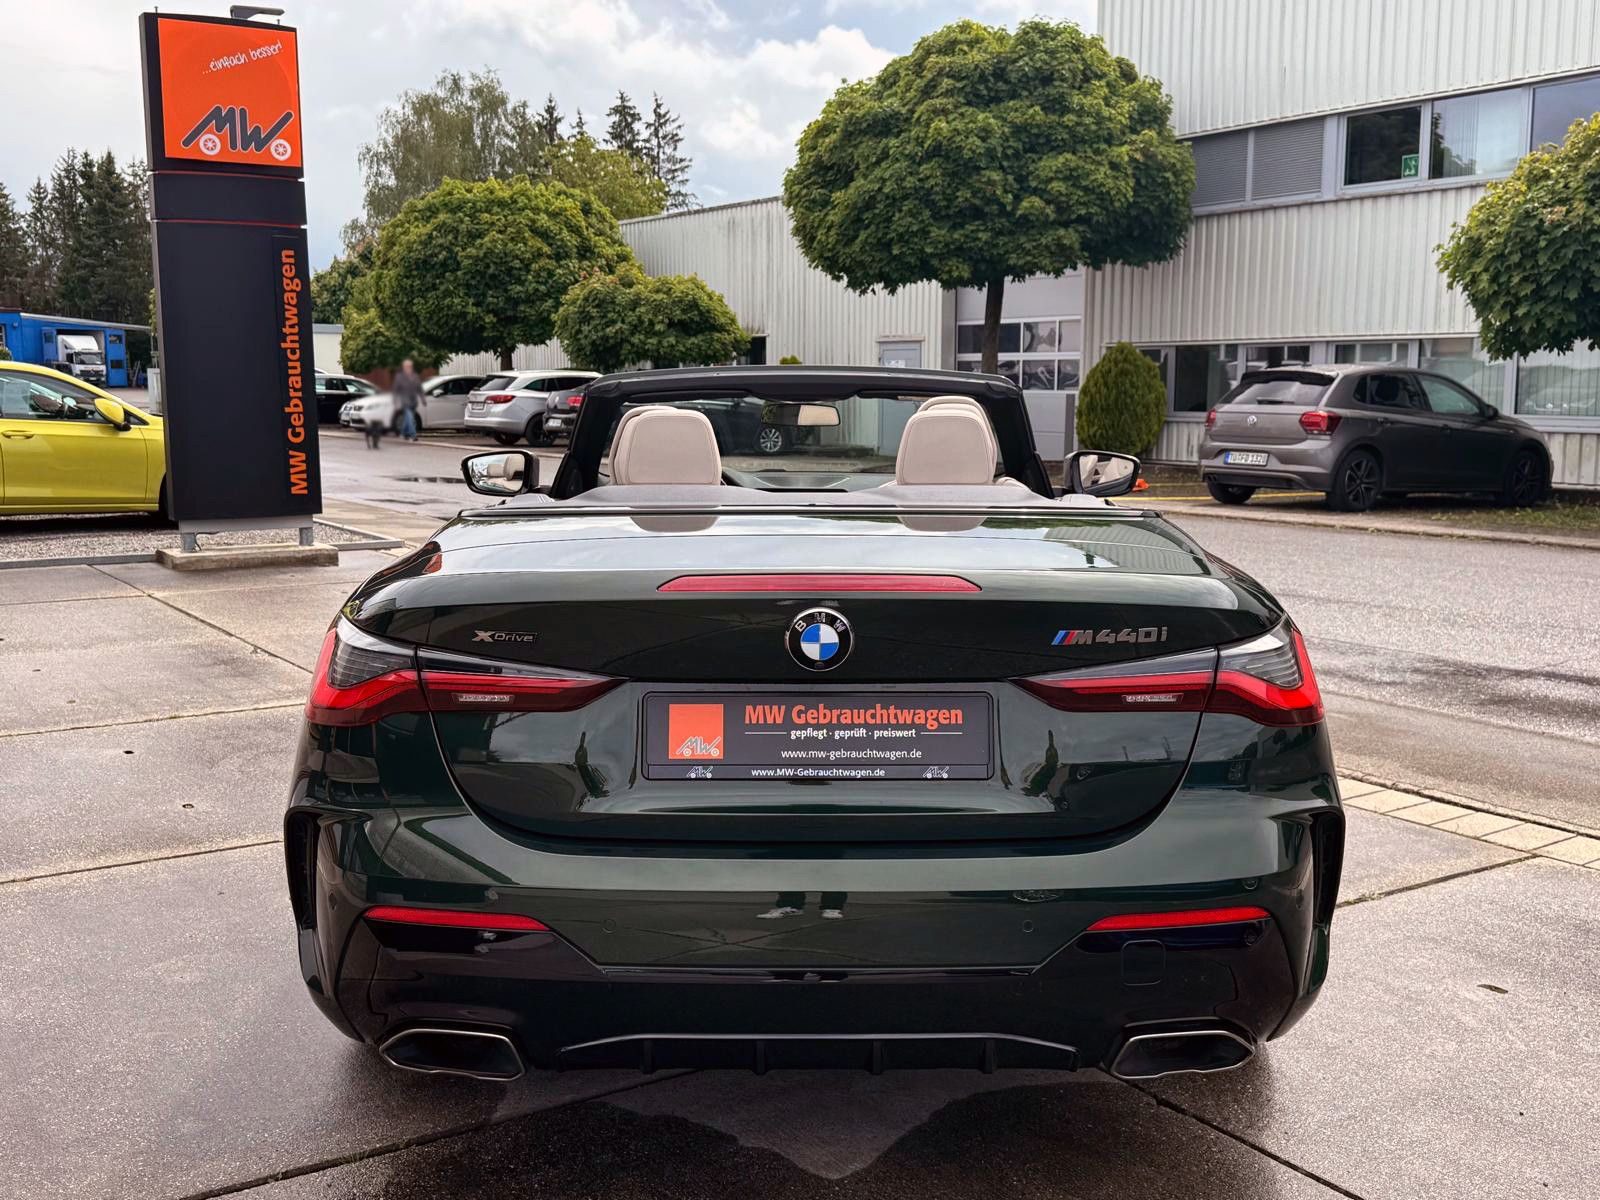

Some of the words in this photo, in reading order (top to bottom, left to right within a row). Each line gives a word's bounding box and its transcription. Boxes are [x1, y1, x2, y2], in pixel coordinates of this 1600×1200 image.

[181, 105, 294, 153] MW
[280, 249, 306, 444] Gebrauchtwagen
[289, 450, 308, 495] MW
[794, 612, 846, 633] BMW
[744, 704, 786, 725] MW
[791, 703, 963, 730] Gebrauchtwagen
[790, 727, 828, 740] gepflegt
[834, 727, 867, 740] geprüft
[873, 727, 917, 740] preiswert
[781, 748, 922, 760] www.mw-gebrauchtwagen.de
[751, 767, 886, 779] www.MW-Gebrauchtwagen.de
